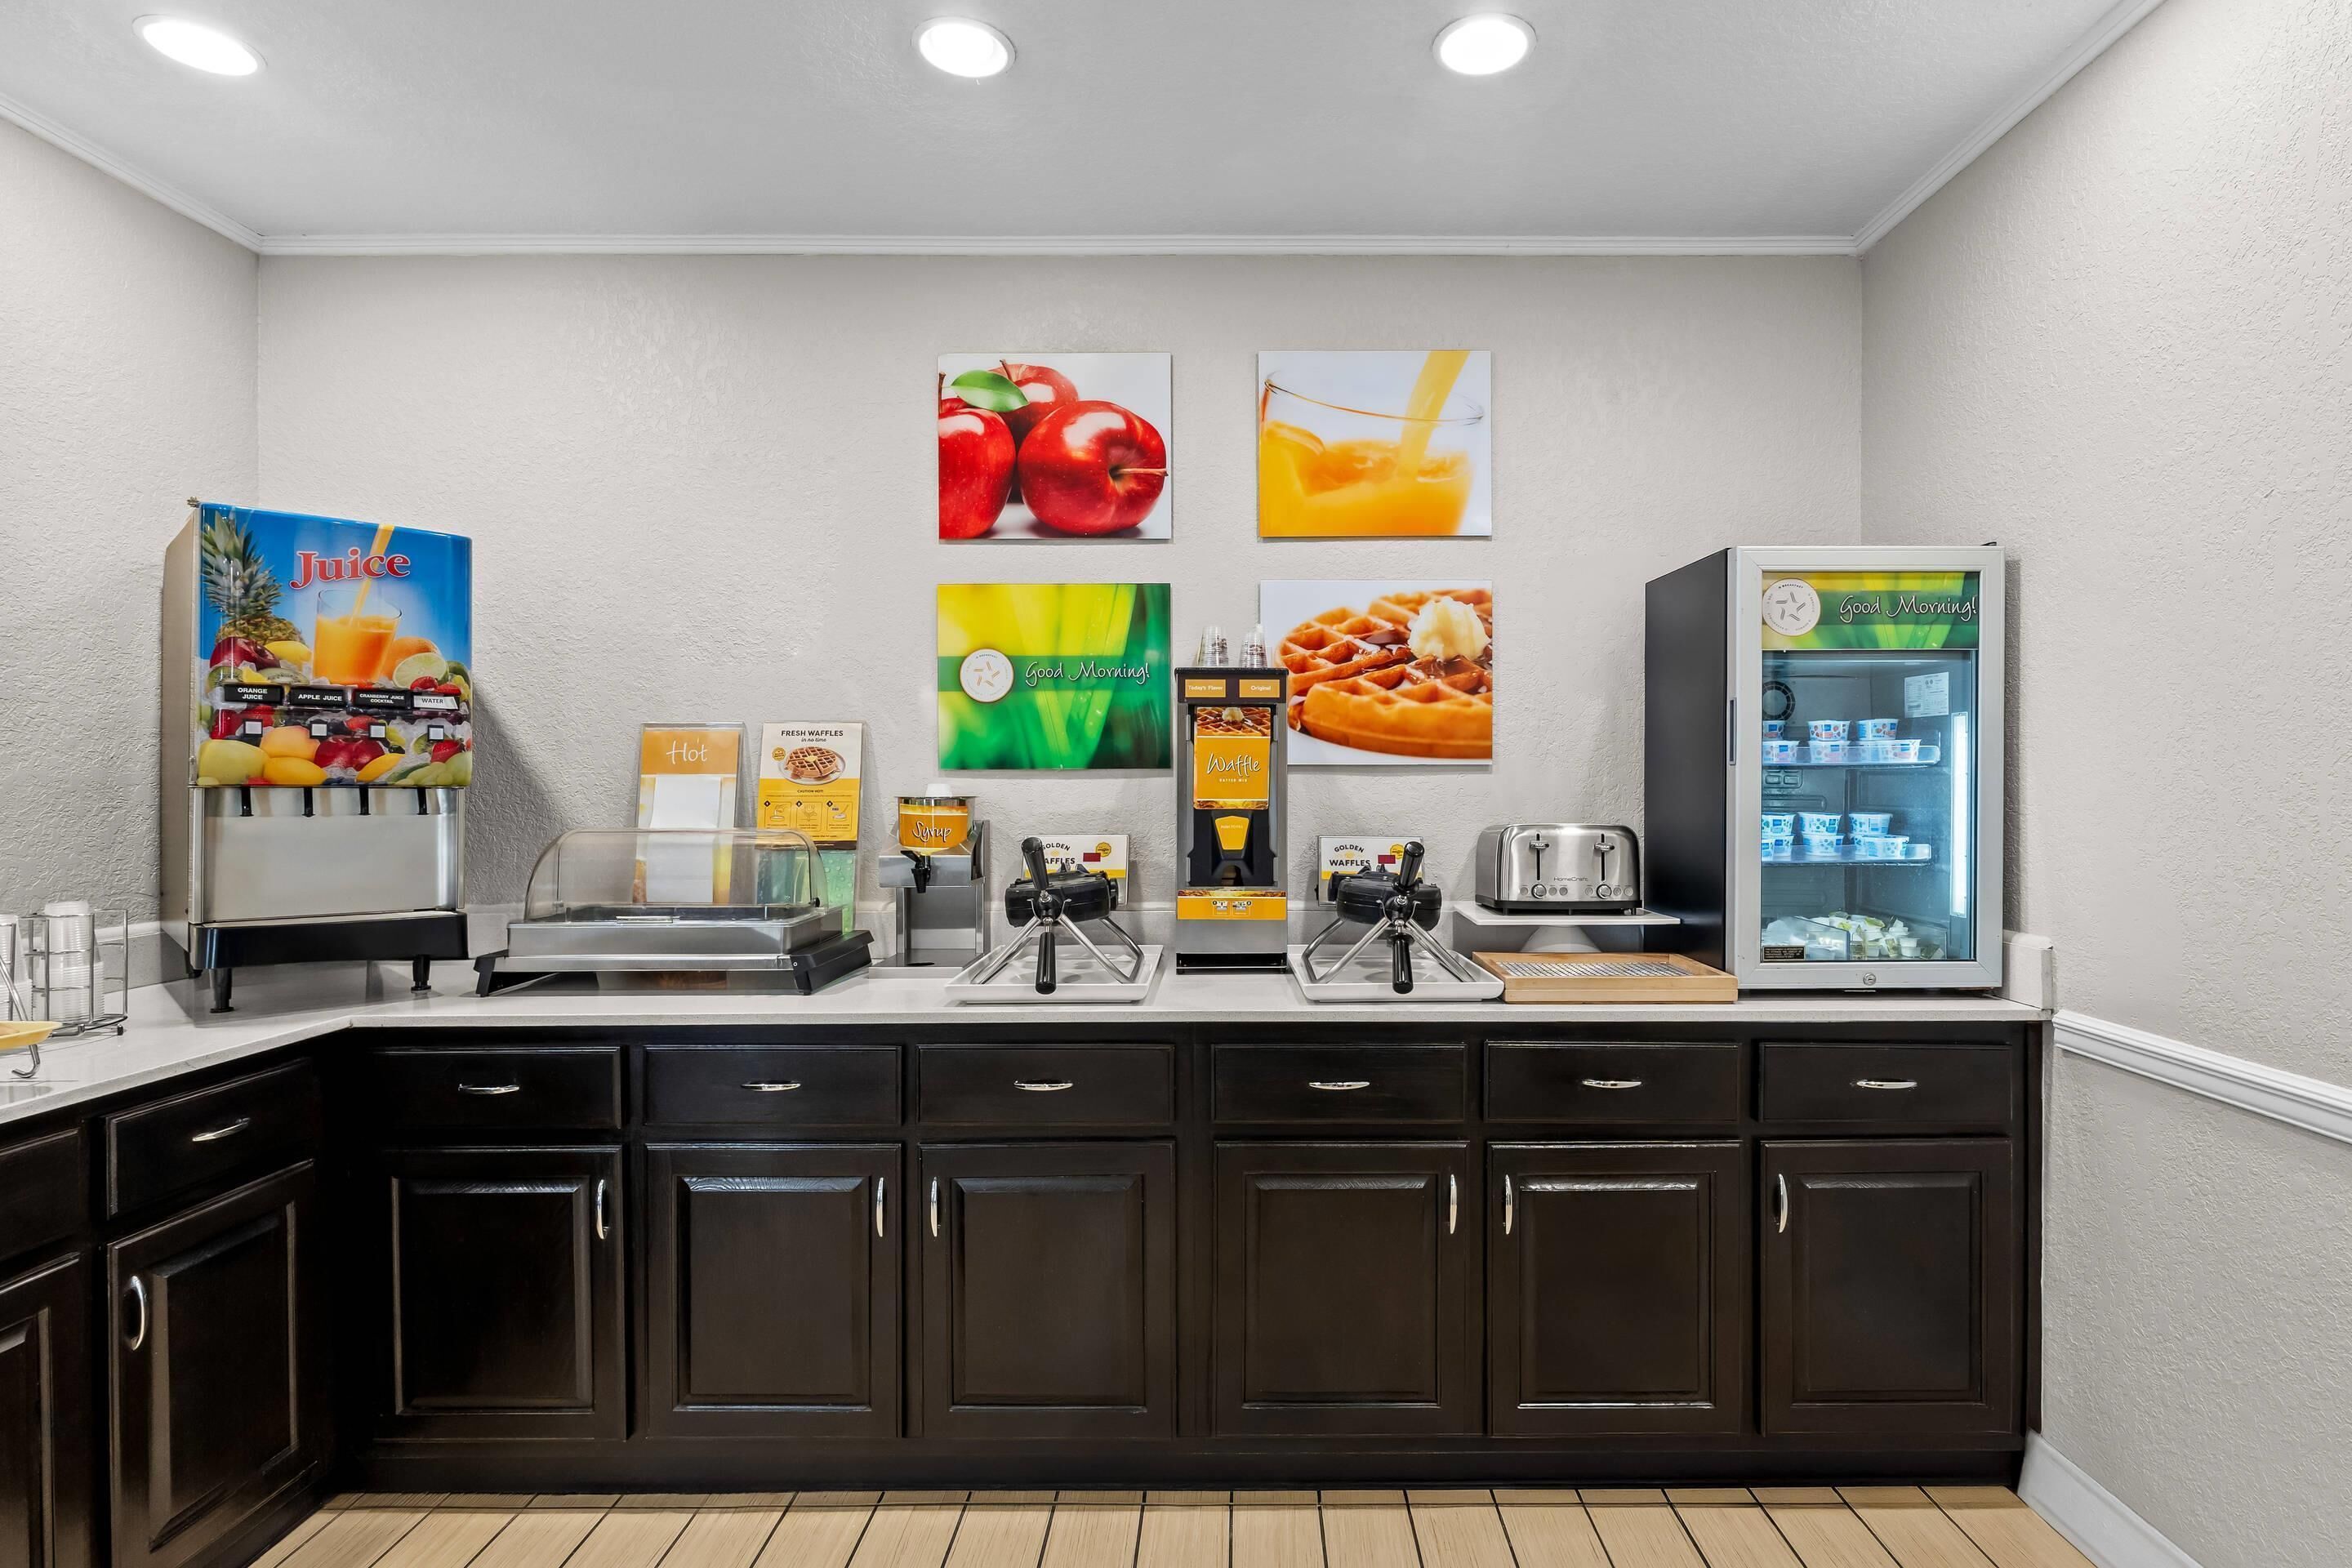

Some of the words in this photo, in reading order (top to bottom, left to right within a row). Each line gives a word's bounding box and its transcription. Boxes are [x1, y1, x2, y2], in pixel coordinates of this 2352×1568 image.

[289, 547, 411, 590] Juice
[1839, 595, 1881, 623] Good
[1886, 595, 1977, 621] Morning!
[1025, 661, 1064, 687] Good
[1068, 661, 1151, 685] Morning!
[666, 738, 709, 765] Hot
[1206, 752, 1261, 777] Waffle
[911, 821, 952, 843] Syrup
[1334, 844, 1365, 853] GOLDEN
